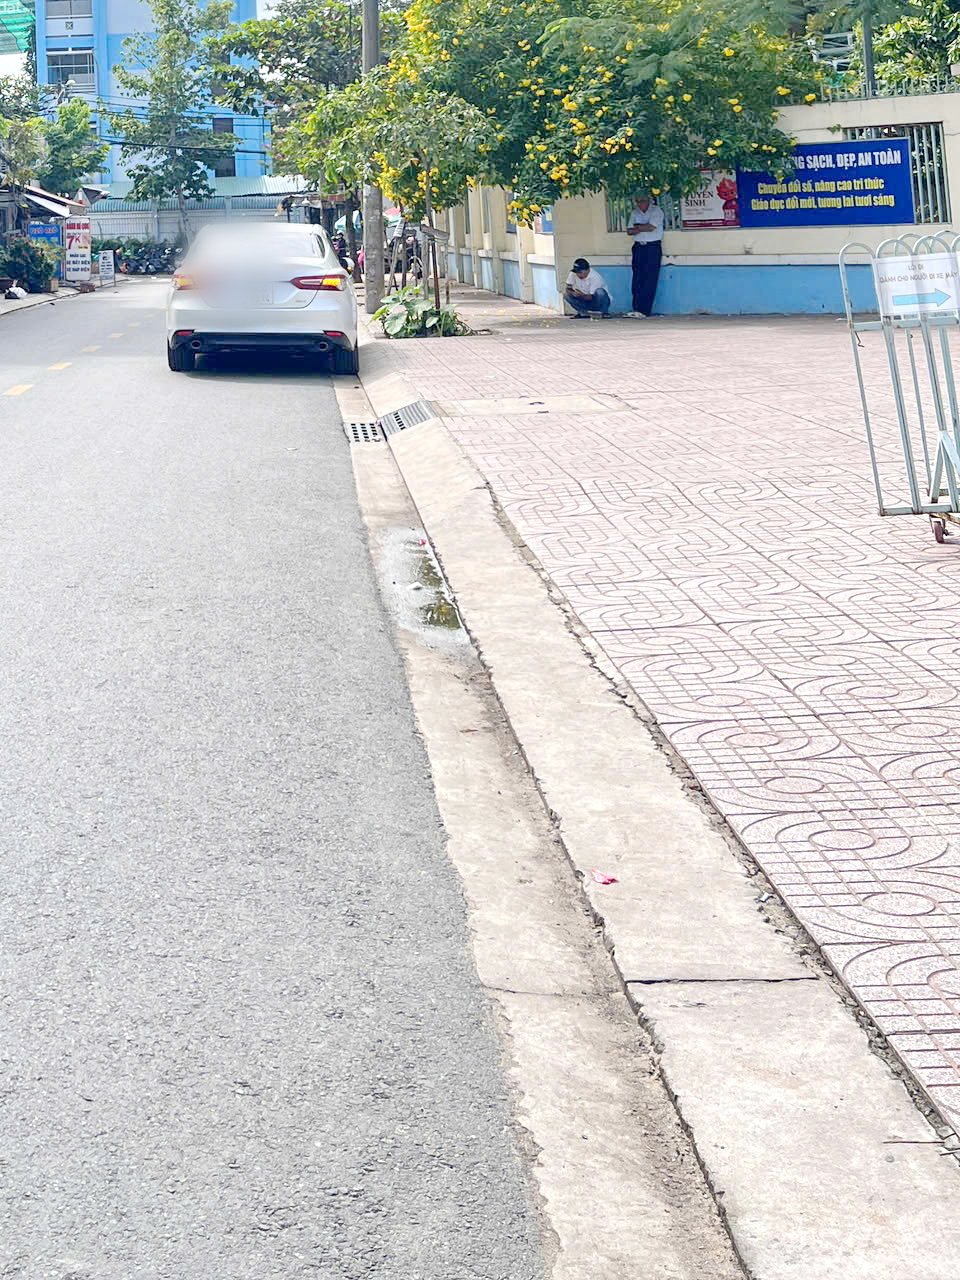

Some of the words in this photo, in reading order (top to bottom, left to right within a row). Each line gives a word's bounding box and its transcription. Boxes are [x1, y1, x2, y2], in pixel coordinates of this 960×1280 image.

[806, 153, 835, 172] SẠCH,
[858, 152, 873, 166] AN
[874, 148, 901, 166] TOÀN
[837, 180, 852, 191] cao
[685, 199, 706, 207] SINH
[843, 195, 854, 206] lai
[873, 194, 895, 207] sáng
